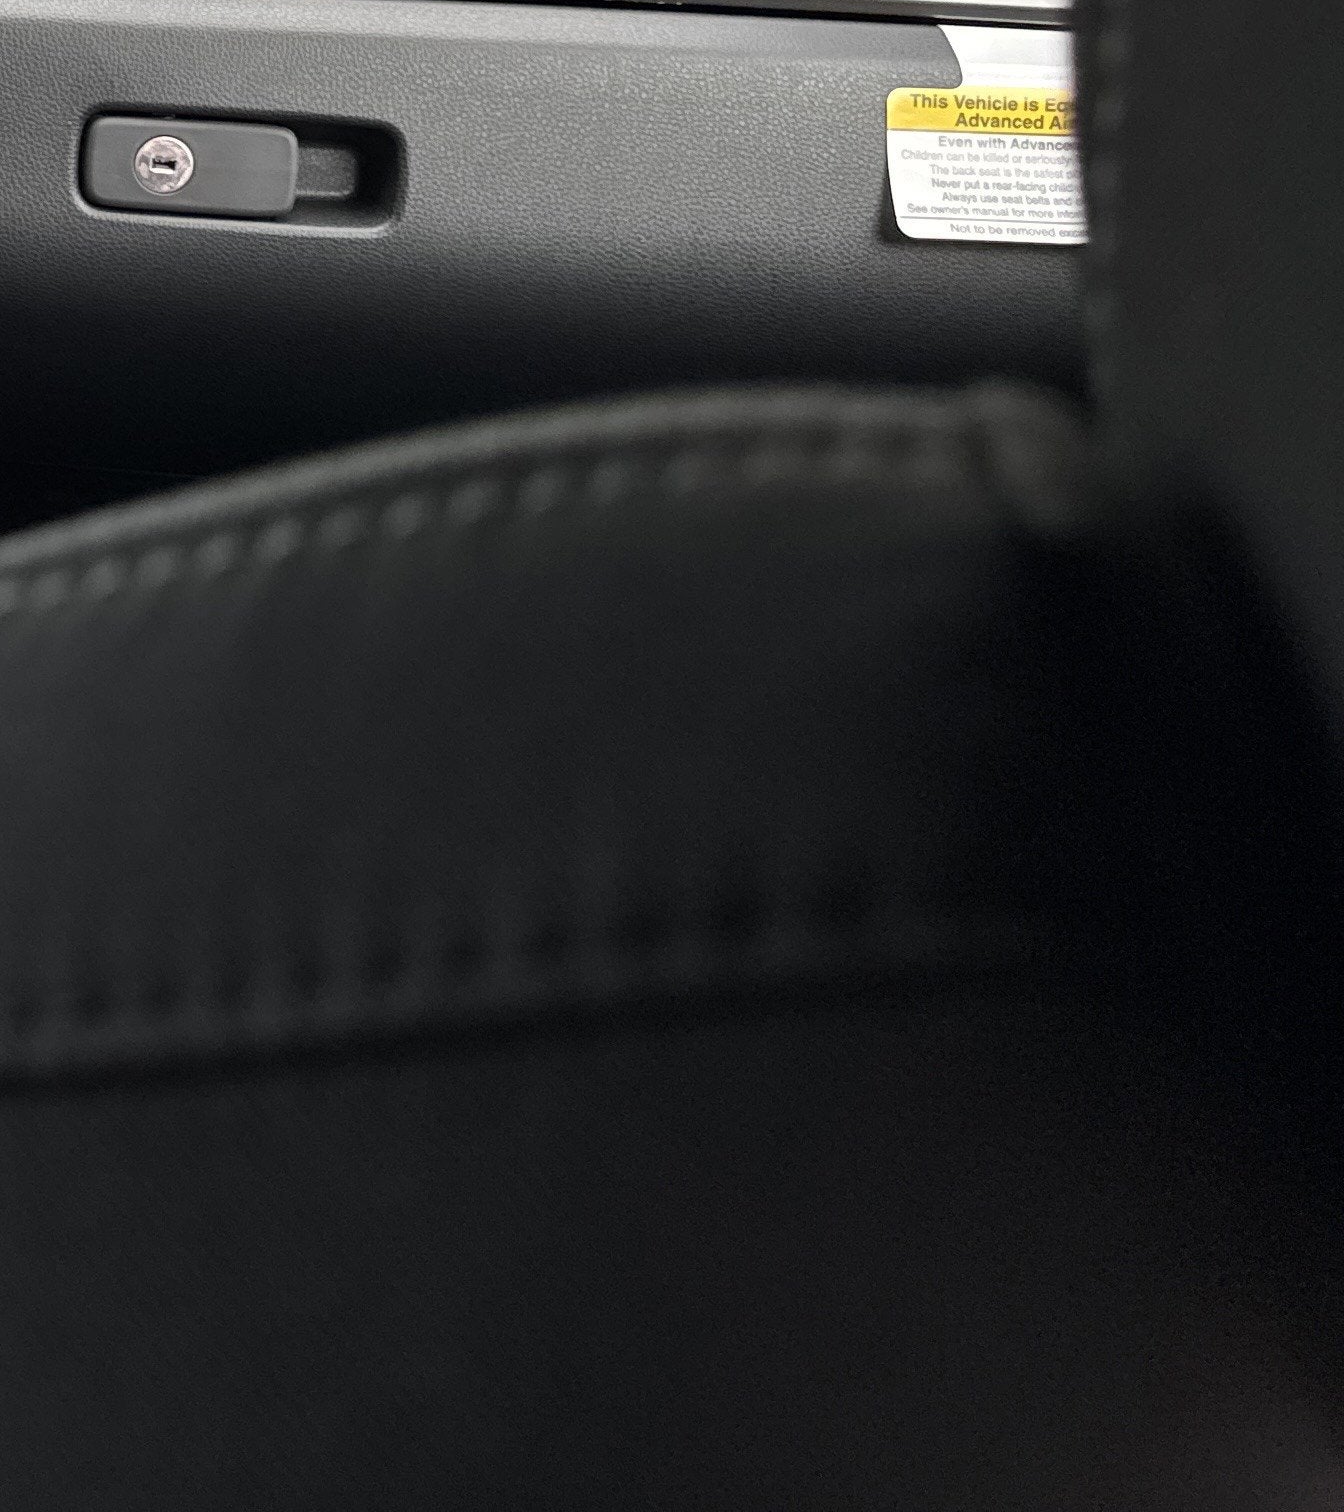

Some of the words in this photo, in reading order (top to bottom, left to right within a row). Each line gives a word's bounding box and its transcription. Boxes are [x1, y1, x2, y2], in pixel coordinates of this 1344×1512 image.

[909, 93, 949, 109] This
[954, 94, 1019, 111] Vehicle
[1024, 97, 1039, 112] is
[955, 112, 1044, 129] Advanced
[938, 136, 973, 148] Even
[977, 137, 1006, 149] with
[900, 149, 943, 161] Children
[947, 153, 964, 161] can
[968, 152, 980, 162] be
[983, 153, 1009, 163] killed
[1013, 156, 1022, 164] or
[929, 163, 949, 175] The
[953, 165, 975, 176] back
[979, 167, 1000, 177] seat
[1004, 167, 1012, 177] is
[1015, 168, 1030, 178] the
[1033, 169, 1063, 179] safest
[931, 178, 961, 189] Never
[964, 180, 980, 191] put
[983, 182, 989, 190] a
[992, 180, 1047, 194] rear-facing
[942, 191, 977, 204] Always
[980, 195, 998, 203] use
[1002, 194, 1023, 204] seat
[1026, 195, 1050, 206] belts
[907, 203, 928, 213] See
[930, 205, 970, 215] owner's
[972, 206, 1009, 216] manual
[1012, 207, 1025, 217] for
[1028, 209, 1054, 218] more
[949, 223, 971, 233] Not
[973, 224, 985, 234] to
[988, 224, 1003, 235] be
[1006, 226, 1055, 237] removed
